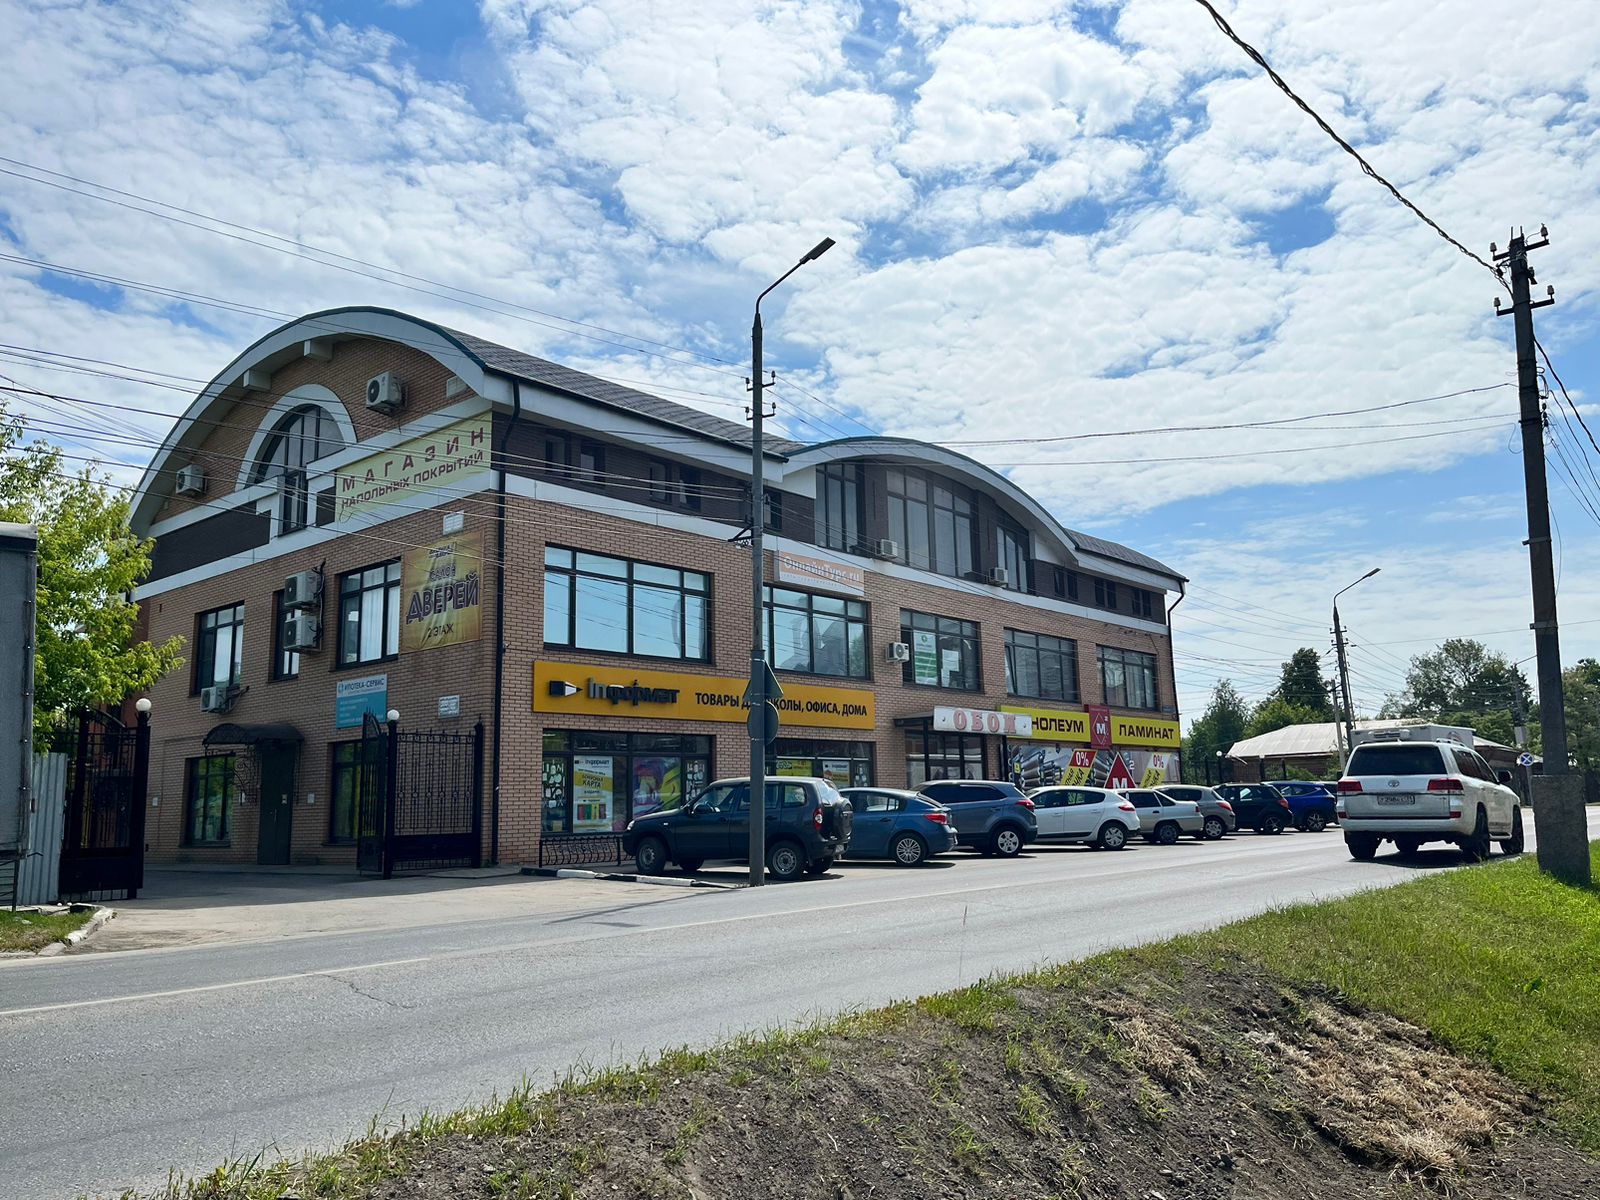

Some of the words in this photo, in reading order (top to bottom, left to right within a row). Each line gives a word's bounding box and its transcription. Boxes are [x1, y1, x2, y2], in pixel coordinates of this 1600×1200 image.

[342, 427, 484, 493] МАГАЗИН
[341, 476, 411, 509] НАПОЛЬНЫХ
[413, 450, 483, 484] ПОКРЫТИЙ
[430, 562, 457, 582] САЛОН
[405, 571, 480, 625] ДВЕРЕЙ
[695, 692, 740, 707] ТОВАРЫ
[805, 700, 840, 715] ОФИСА,
[842, 703, 868, 717] ДОМА
[953, 707, 1017, 734] ОБОИ
[1032, 717, 1084, 734] НОЛЕУМ
[1119, 724, 1174, 740] ЛАМИНАТ
[1075, 751, 1090, 767] 0%
[1153, 754, 1164, 769] 0%
[582, 779, 601, 788] КАРТА
